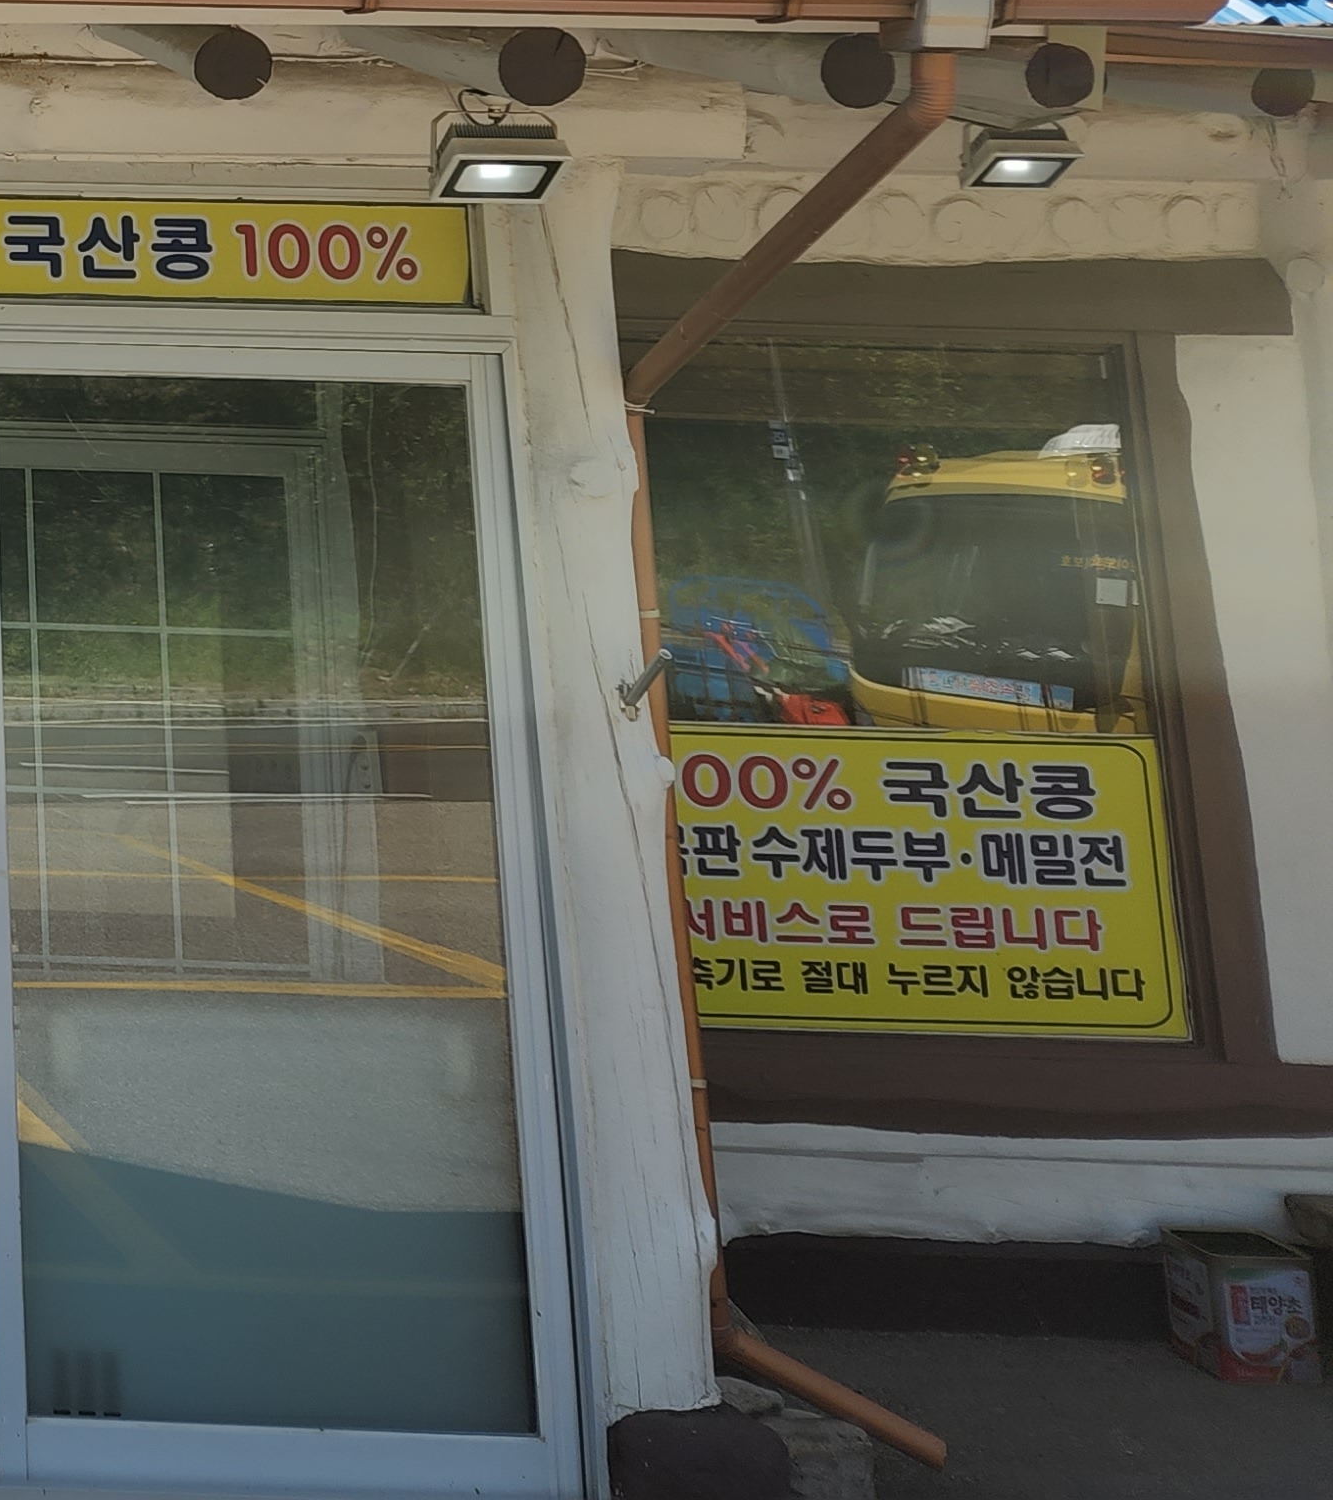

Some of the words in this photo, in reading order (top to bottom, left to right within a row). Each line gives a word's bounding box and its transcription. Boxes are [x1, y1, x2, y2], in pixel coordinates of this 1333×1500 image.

[4, 213, 214, 281] 국산콩
[234, 221, 420, 283] 100%
[681, 753, 852, 811] 00%
[882, 761, 1097, 821] 국산콩
[678, 823, 742, 877] 판
[685, 898, 876, 946] 서비스로
[899, 906, 1103, 952] 드립니다
[693, 956, 786, 992] 축기로
[800, 960, 869, 995] 절대
[887, 962, 990, 999] 누르지
[1006, 966, 1147, 1001] 않습니다
